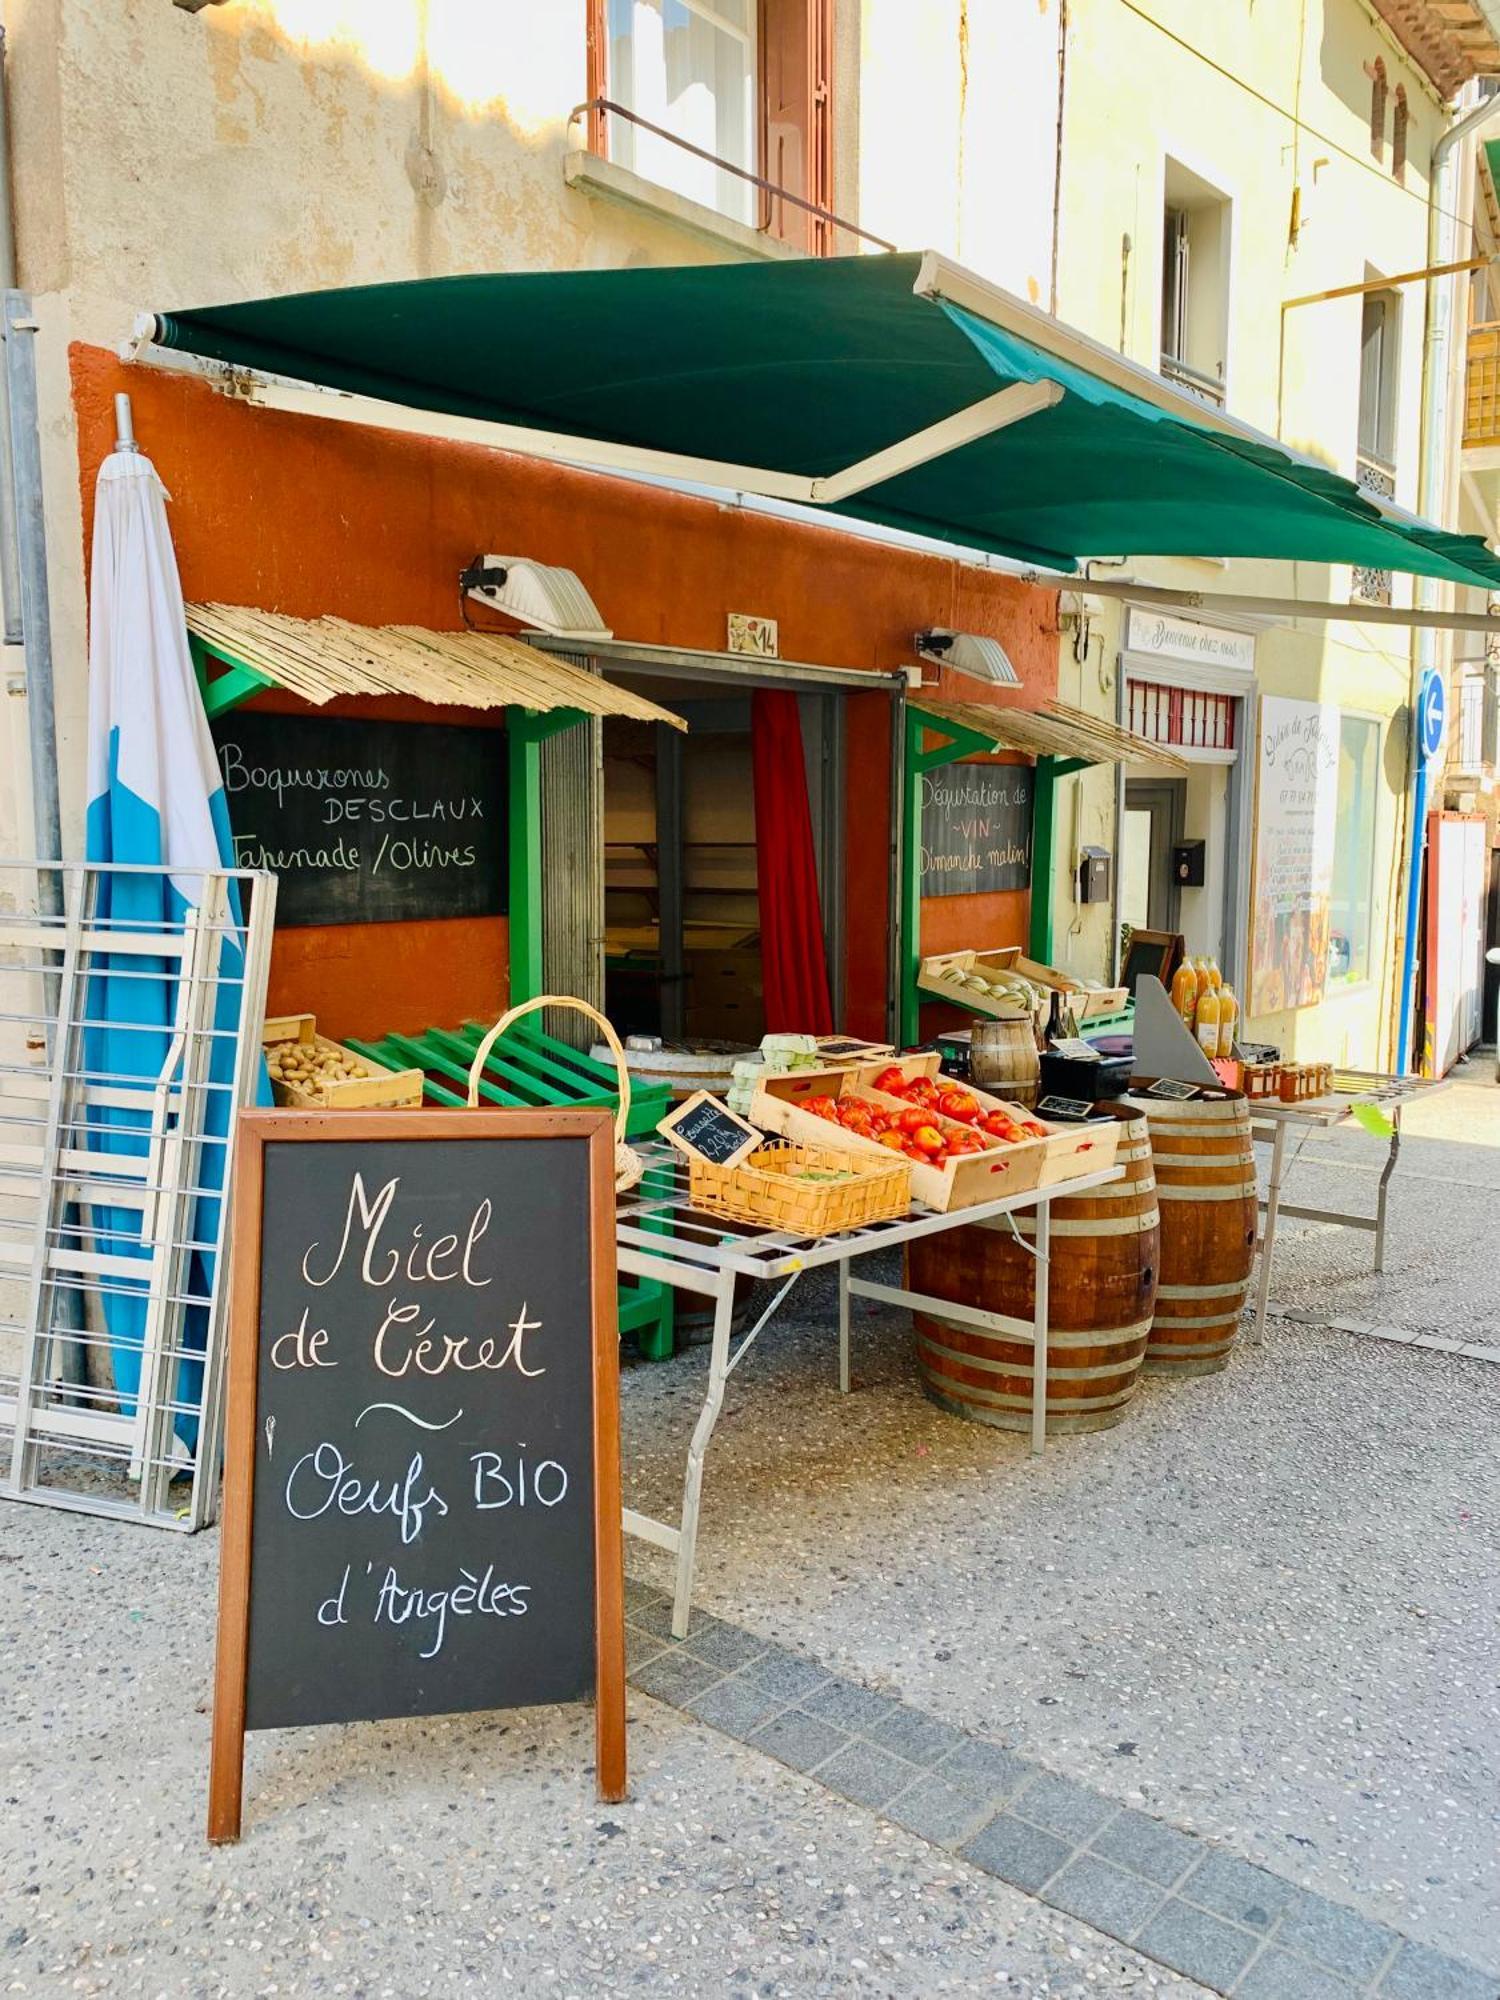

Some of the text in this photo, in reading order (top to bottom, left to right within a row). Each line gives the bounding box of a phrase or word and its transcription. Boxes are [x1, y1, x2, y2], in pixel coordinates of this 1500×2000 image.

[219, 743, 390, 808] Boquerones
[1013, 784, 1028, 806] de
[322, 797, 484, 824] DESCLAUX
[919, 842, 984, 876] Dimanche
[301, 1172, 493, 1287] Miel
[270, 1297, 546, 1377] de Céret
[285, 1442, 449, 1544] Oeufs
